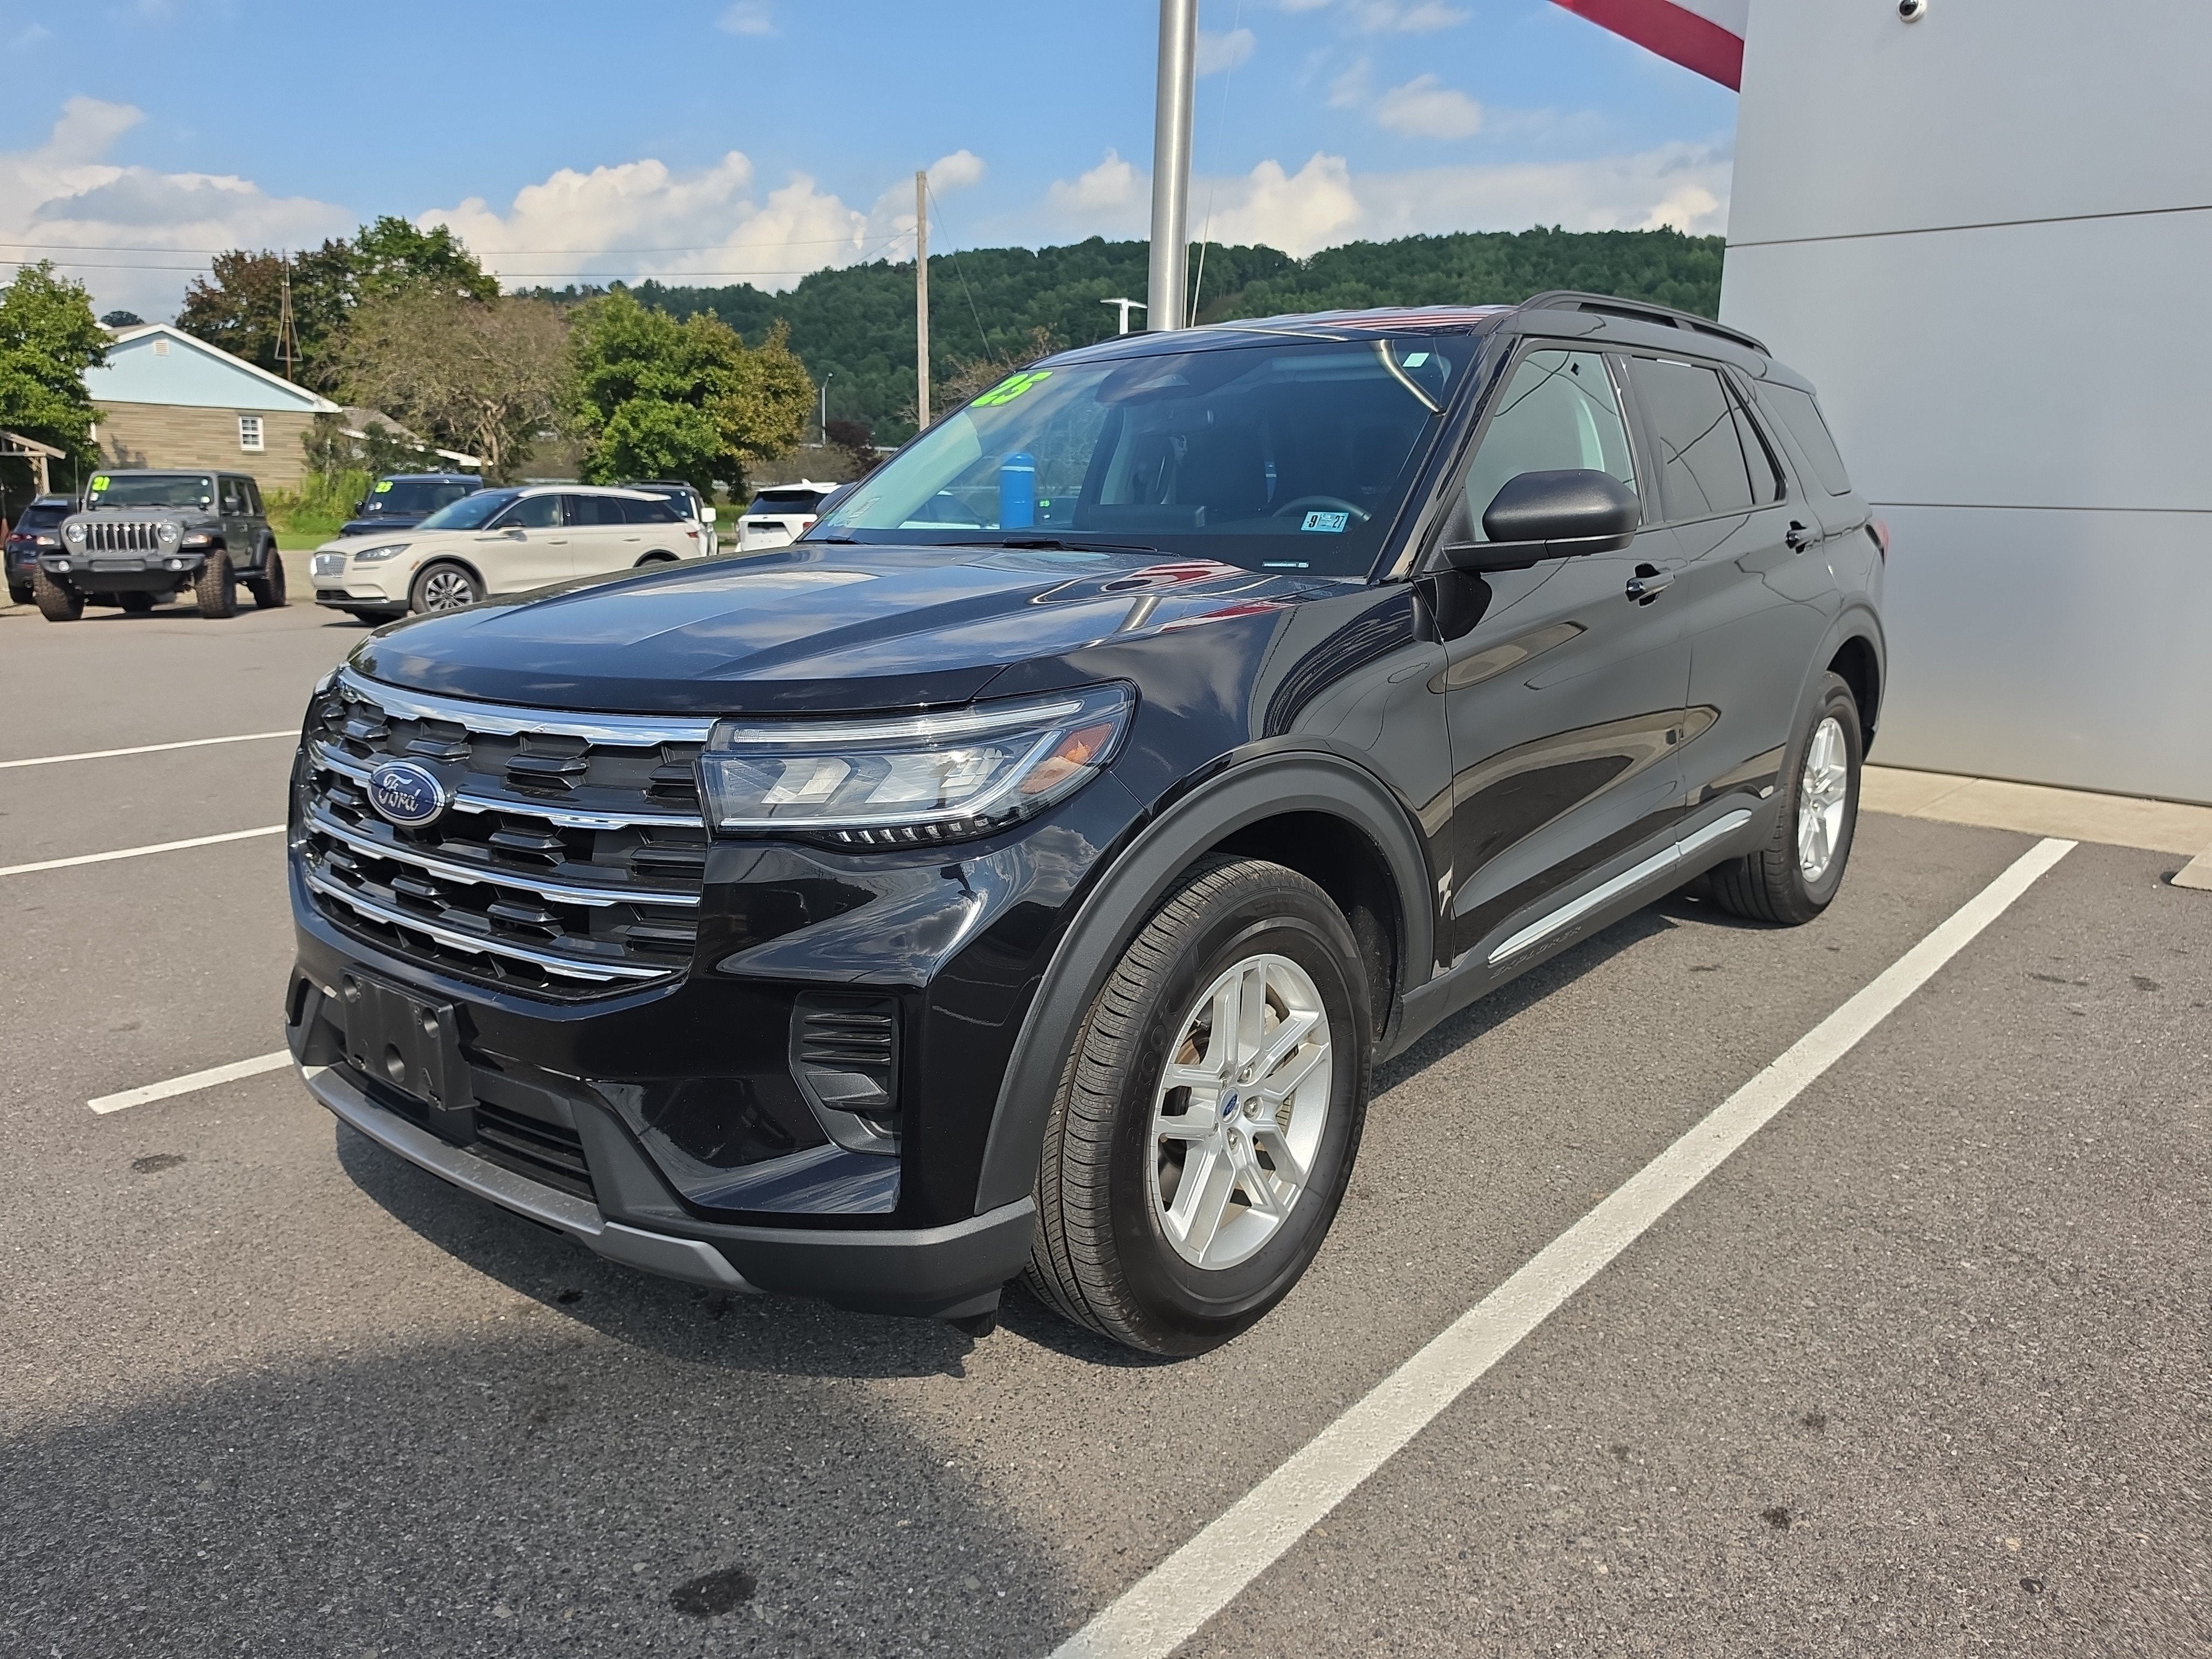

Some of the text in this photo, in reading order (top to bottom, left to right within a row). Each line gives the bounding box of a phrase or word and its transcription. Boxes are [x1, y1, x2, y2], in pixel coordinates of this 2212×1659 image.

[969, 371, 1053, 408] 25
[92, 476, 111, 491] 21
[375, 481, 394, 493] 25
[1308, 515, 1345, 529] 9 27
[378, 773, 422, 812] Ford
[1489, 925, 1582, 980] EXPLORER
